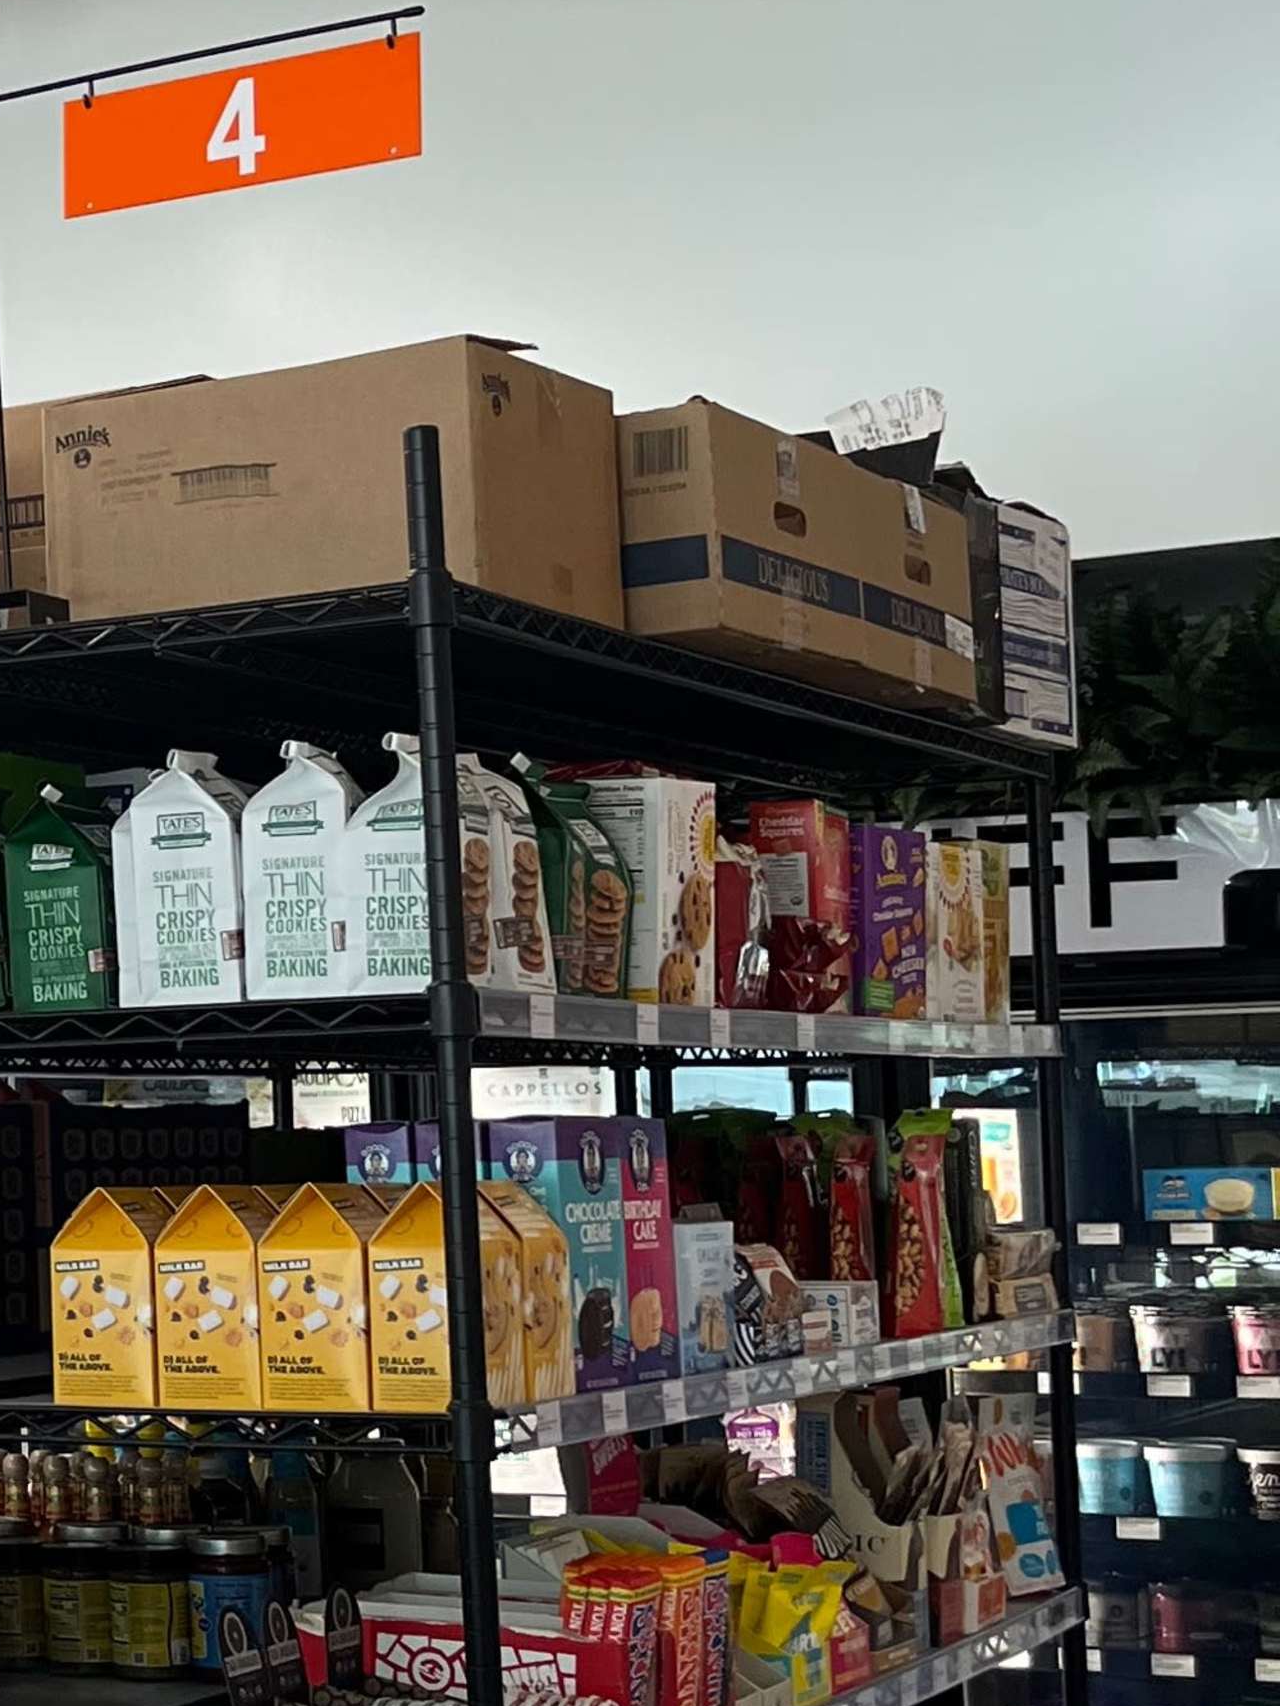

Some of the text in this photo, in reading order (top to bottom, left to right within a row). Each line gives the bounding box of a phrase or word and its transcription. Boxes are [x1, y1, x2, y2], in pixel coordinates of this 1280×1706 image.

[205, 77, 267, 175] 4
[55, 425, 112, 454] Annie's
[759, 552, 830, 603] DELICIOUS
[759, 816, 806, 827] Cheddar
[262, 856, 325, 870] SIGNATURE
[152, 867, 214, 883] SIGNATURE
[263, 871, 324, 897] THIN
[365, 868, 427, 894] THIN
[24, 886, 79, 903] SIGNATURE
[154, 882, 213, 909] THIN
[25, 901, 80, 927] THIN
[266, 898, 327, 919] CRISPY
[366, 895, 428, 915] CRISPY
[155, 909, 215, 930] CRISPY
[266, 917, 327, 934] COOKIES
[366, 915, 430, 931] COOKIES
[28, 925, 82, 947] CRISPY
[156, 927, 216, 945] COOKIES
[29, 944, 85, 962] COOKIES
[267, 958, 328, 978] BAKING
[367, 957, 431, 976] BAKING
[160, 967, 220, 988] BAKING
[33, 980, 88, 1003] BAKING
[564, 1201, 621, 1224] CHOCOLATE
[632, 1221, 657, 1241] CAKE
[78, 1261, 98, 1270] BAR
[59, 1362, 113, 1372] THE ABOVE.
[69, 1352, 102, 1363] ALL OF
